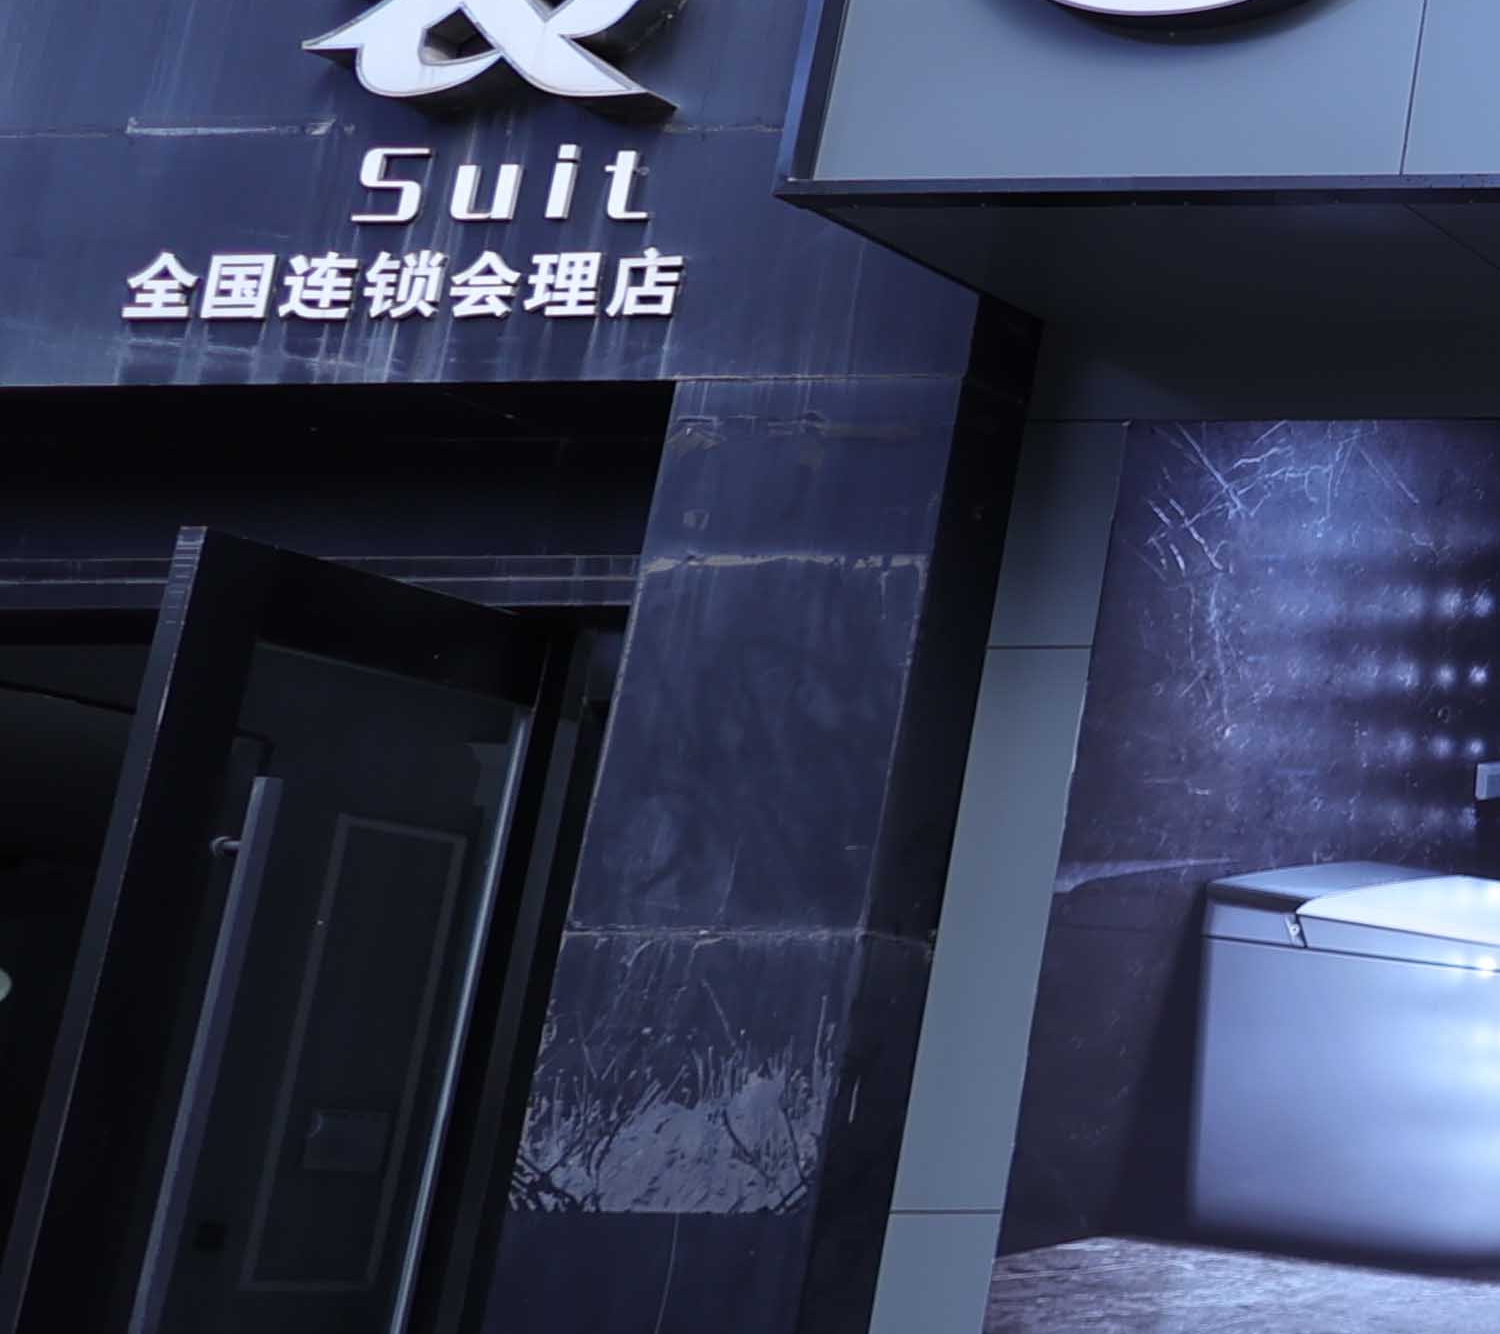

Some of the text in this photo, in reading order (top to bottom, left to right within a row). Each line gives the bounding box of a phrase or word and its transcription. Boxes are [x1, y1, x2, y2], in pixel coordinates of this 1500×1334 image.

[350, 143, 652, 222] Suit
[121, 246, 686, 320] 全国连锁会理店
